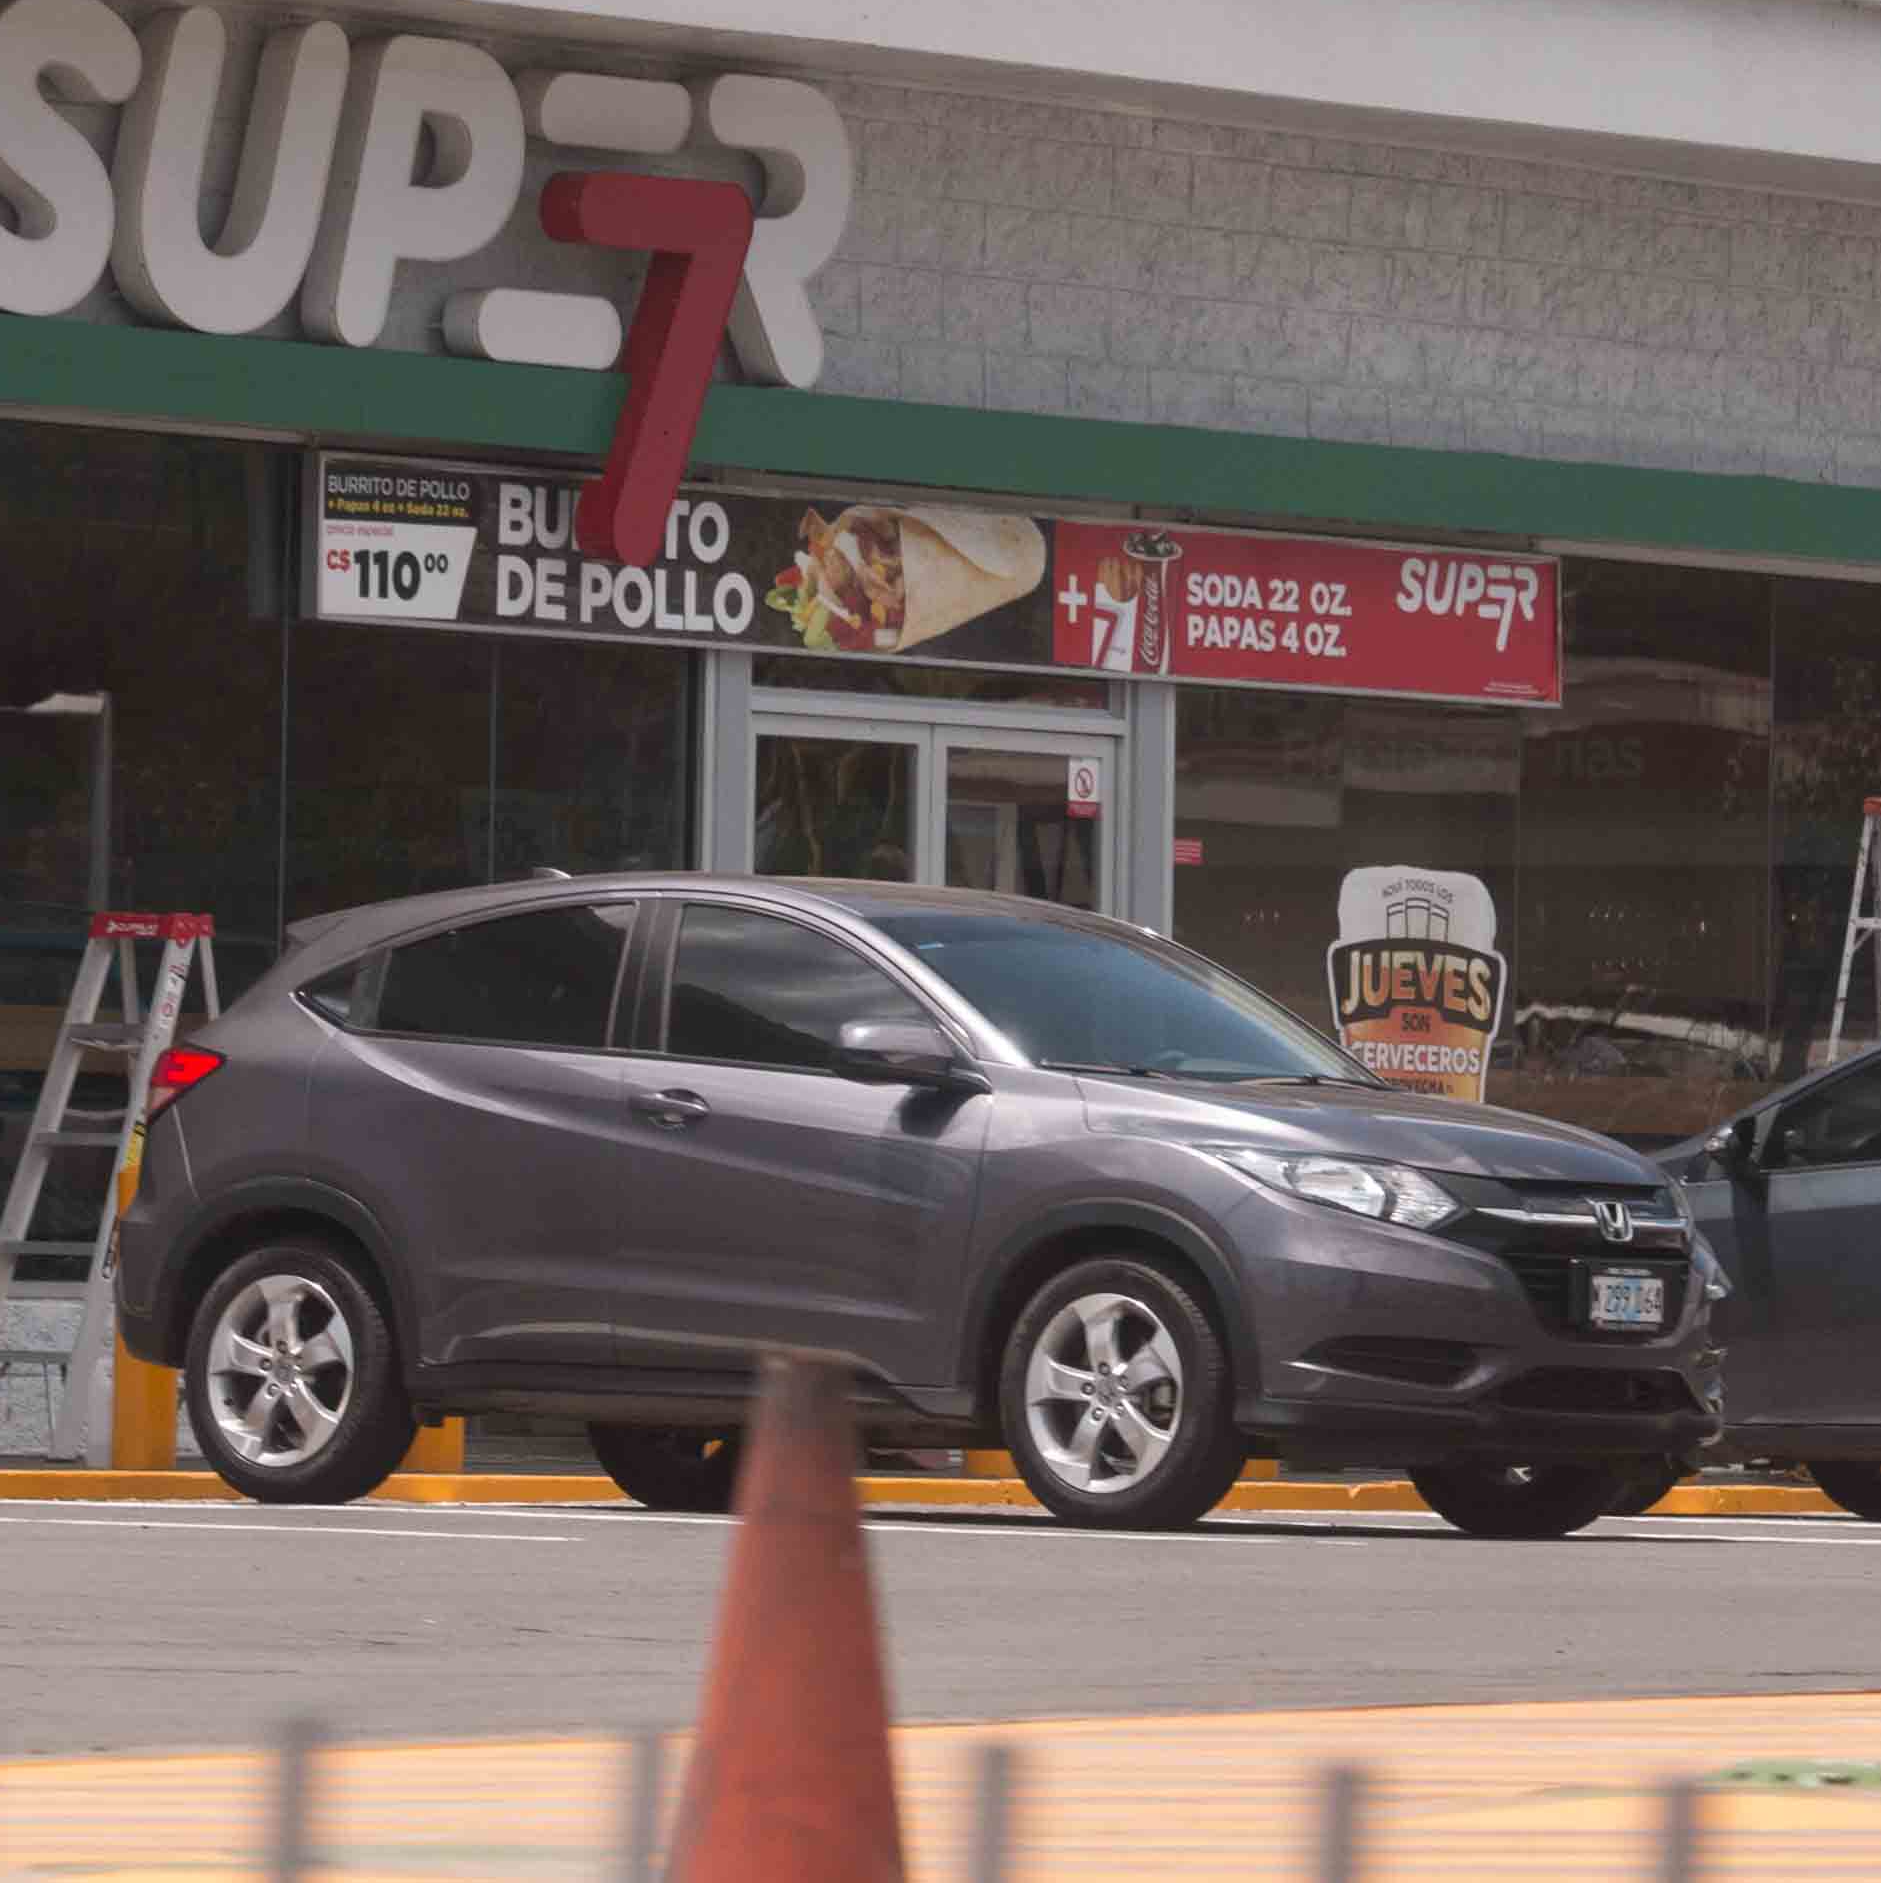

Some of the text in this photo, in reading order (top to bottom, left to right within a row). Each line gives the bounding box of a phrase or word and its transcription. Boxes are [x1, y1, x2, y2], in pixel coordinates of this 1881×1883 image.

[327, 474, 470, 501] BURRITO DE POLLO
[498, 482, 730, 564] BUTO
[496, 554, 755, 635] DE POLLO
[1186, 572, 1353, 616] SODA 22 OZ.
[1187, 615, 1348, 657] PAPAS 4 OZ.
[1340, 950, 1492, 1022] JUEVES
[1401, 1012, 1431, 1033] SON
